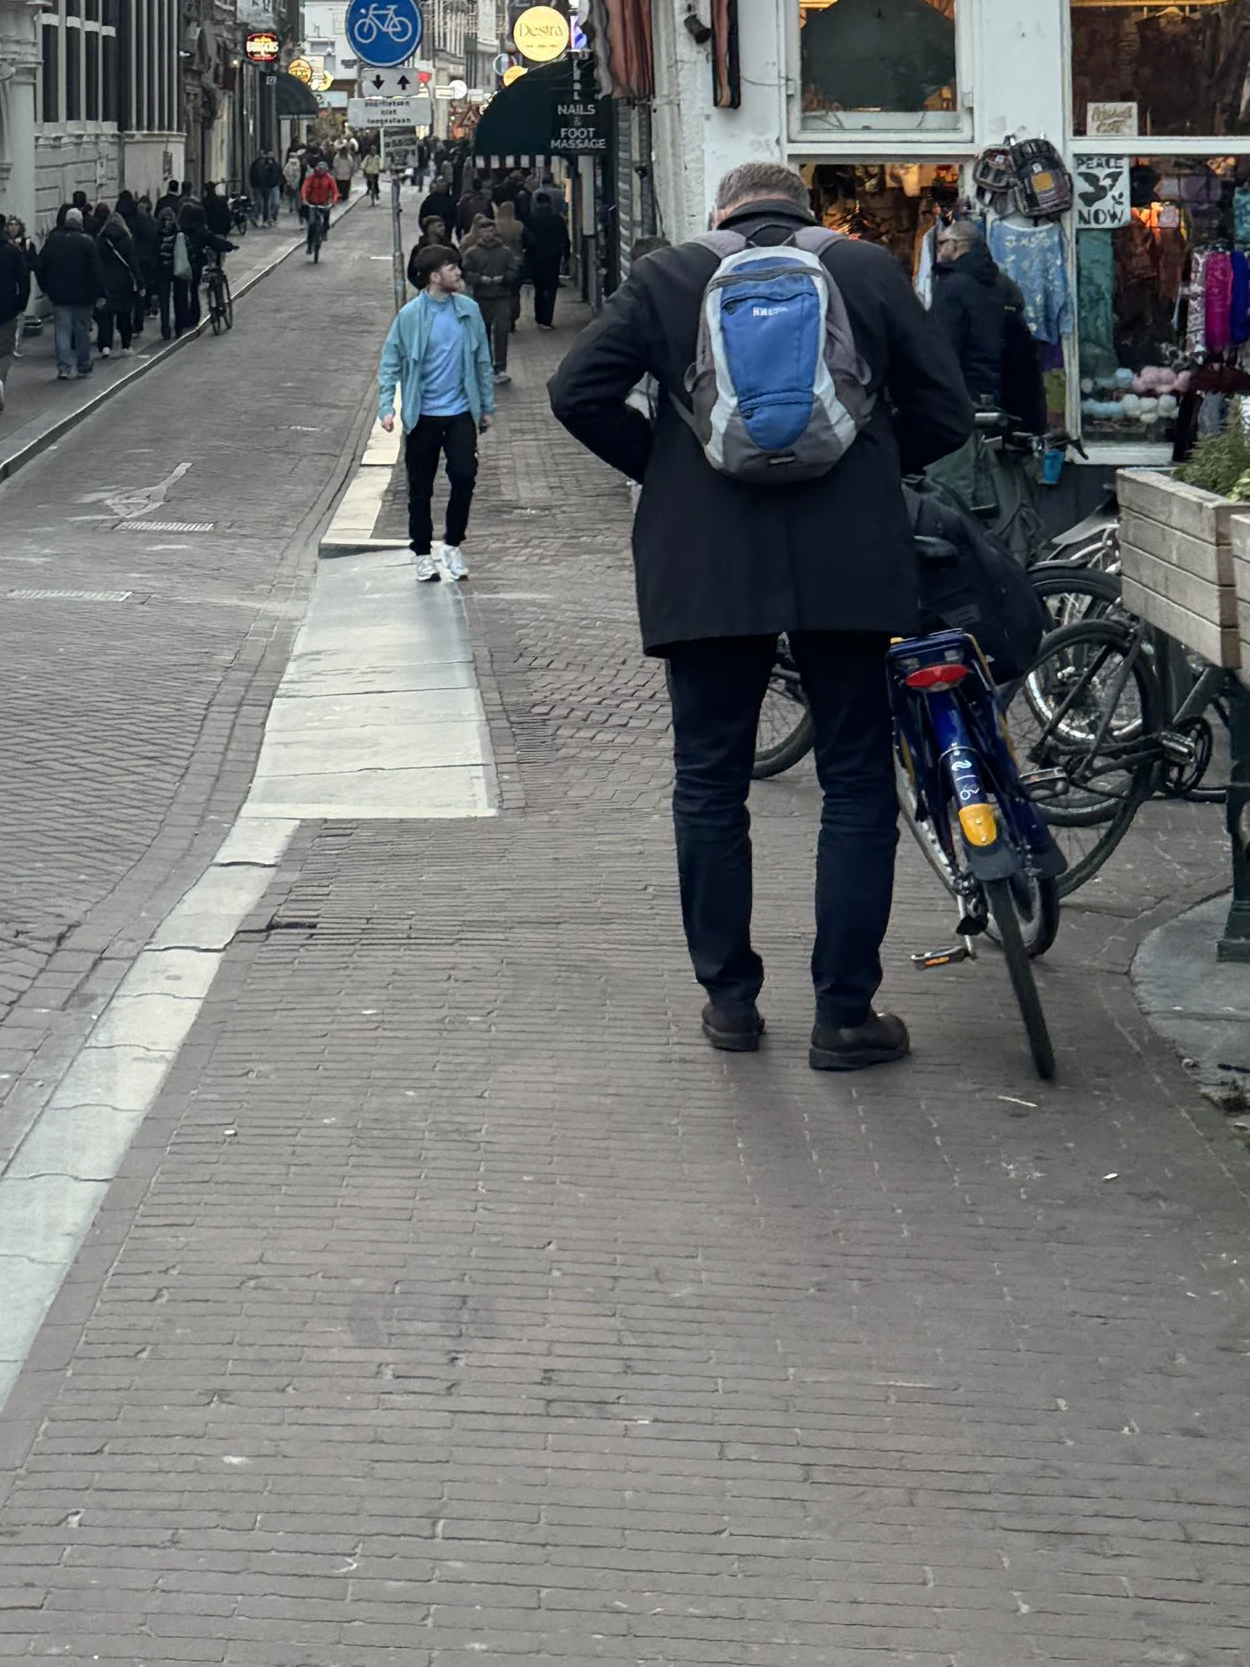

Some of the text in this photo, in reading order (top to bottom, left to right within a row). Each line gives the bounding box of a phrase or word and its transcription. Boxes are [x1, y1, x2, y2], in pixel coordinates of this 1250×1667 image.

[557, 104, 596, 115] NAILS
[560, 127, 596, 139] FOOT
[550, 139, 606, 150] MASSAGE
[1076, 156, 1124, 170] PEACE
[1078, 208, 1124, 225] NOW
